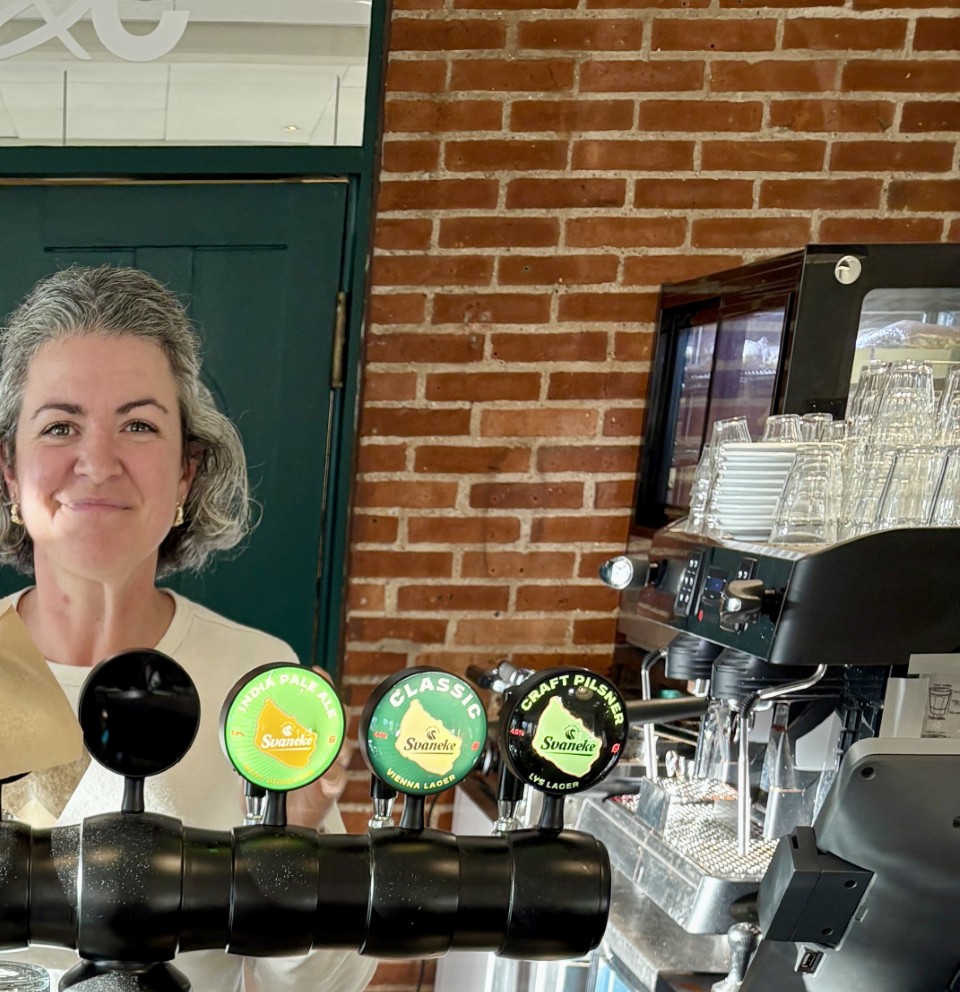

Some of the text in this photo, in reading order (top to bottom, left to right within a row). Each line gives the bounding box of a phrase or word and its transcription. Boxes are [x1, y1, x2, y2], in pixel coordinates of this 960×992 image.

[238, 673, 338, 719] INDIA PALE ALE
[389, 676, 482, 720] CLASSIC
[520, 674, 625, 726] CRAFT PILSNER
[260, 733, 313, 750] Svaneke
[403, 736, 457, 752] Svaneke
[540, 735, 597, 753] Svaneke
[386, 767, 457, 790] VIENNA LAGER
[528, 772, 580, 790] LYS LAGER
